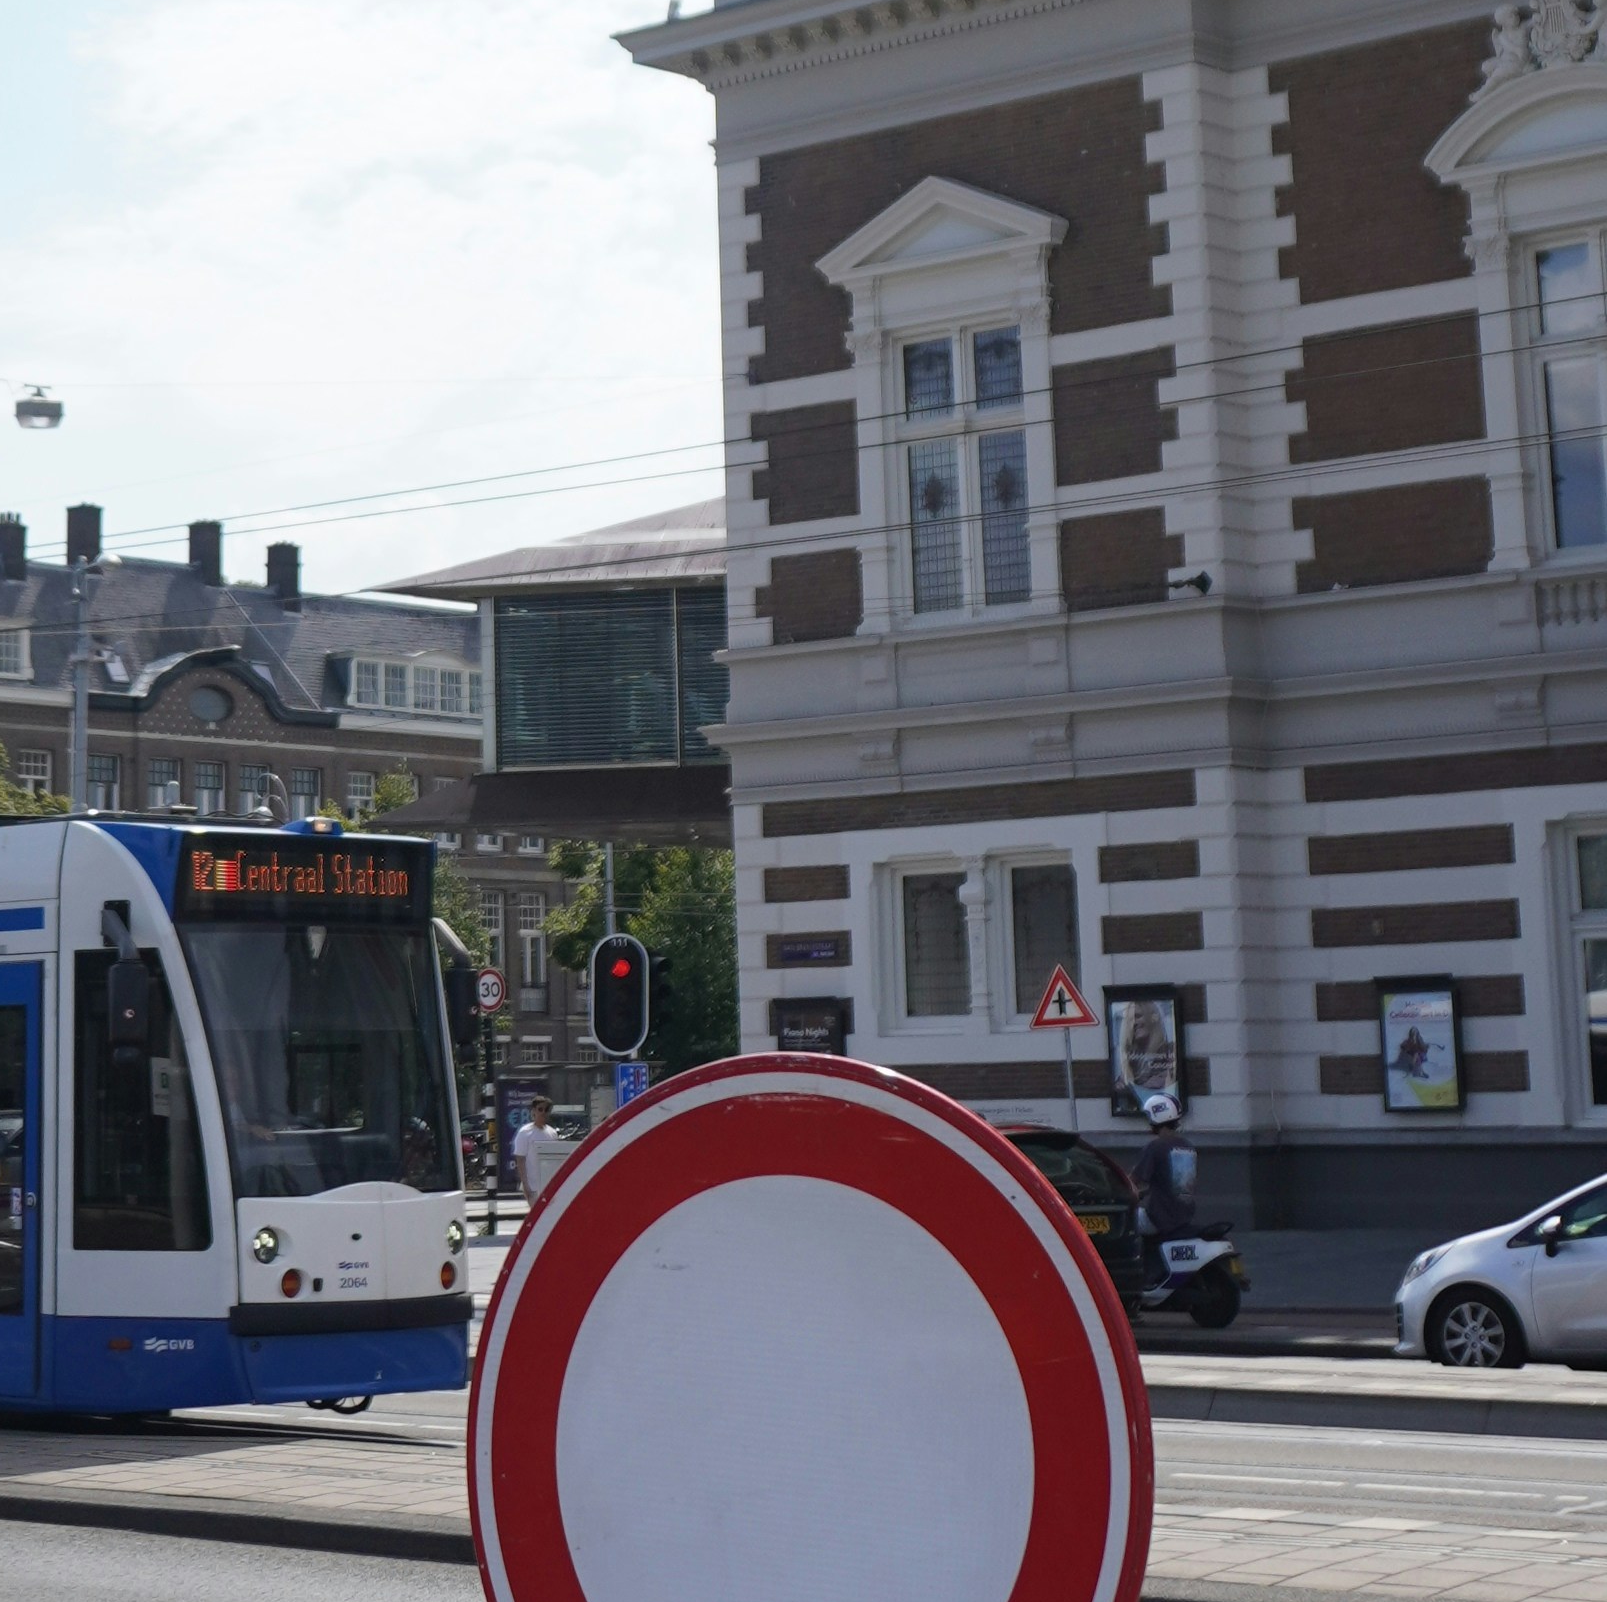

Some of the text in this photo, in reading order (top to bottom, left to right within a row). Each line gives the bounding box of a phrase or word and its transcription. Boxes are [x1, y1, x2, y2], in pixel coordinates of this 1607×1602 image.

[235, 850, 326, 894] Centraal
[331, 854, 409, 896] Station
[481, 982, 501, 998] 30
[340, 1277, 368, 1289] 2064
[169, 1339, 195, 1351] GVB
